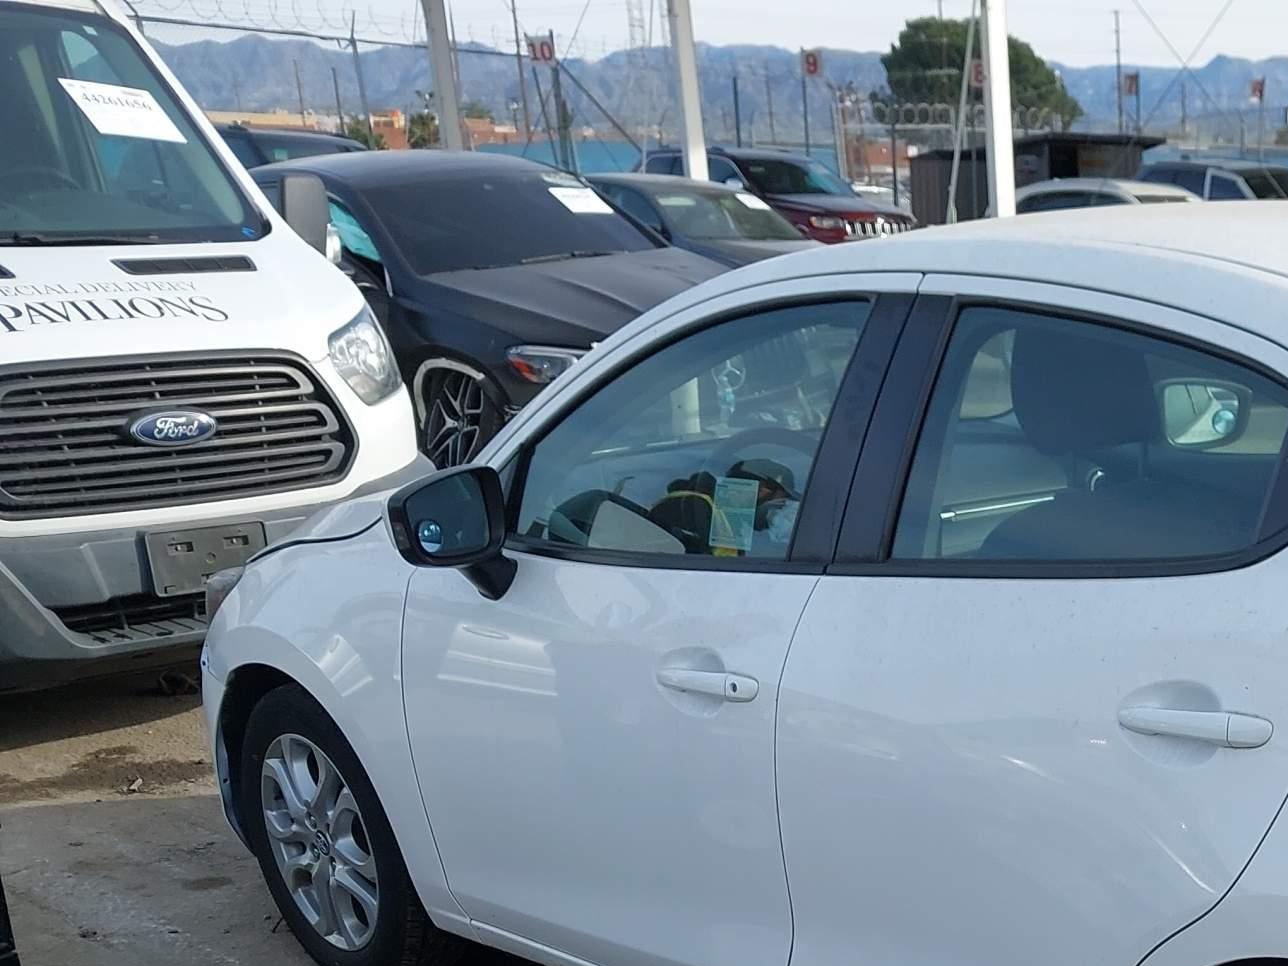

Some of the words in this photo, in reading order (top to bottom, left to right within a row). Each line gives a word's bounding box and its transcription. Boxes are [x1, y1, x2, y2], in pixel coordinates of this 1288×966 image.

[528, 40, 553, 62] 10
[78, 280, 198, 295] DELIVERY
[0, 296, 229, 332] PAVILIONS
[153, 416, 200, 439] Ford
